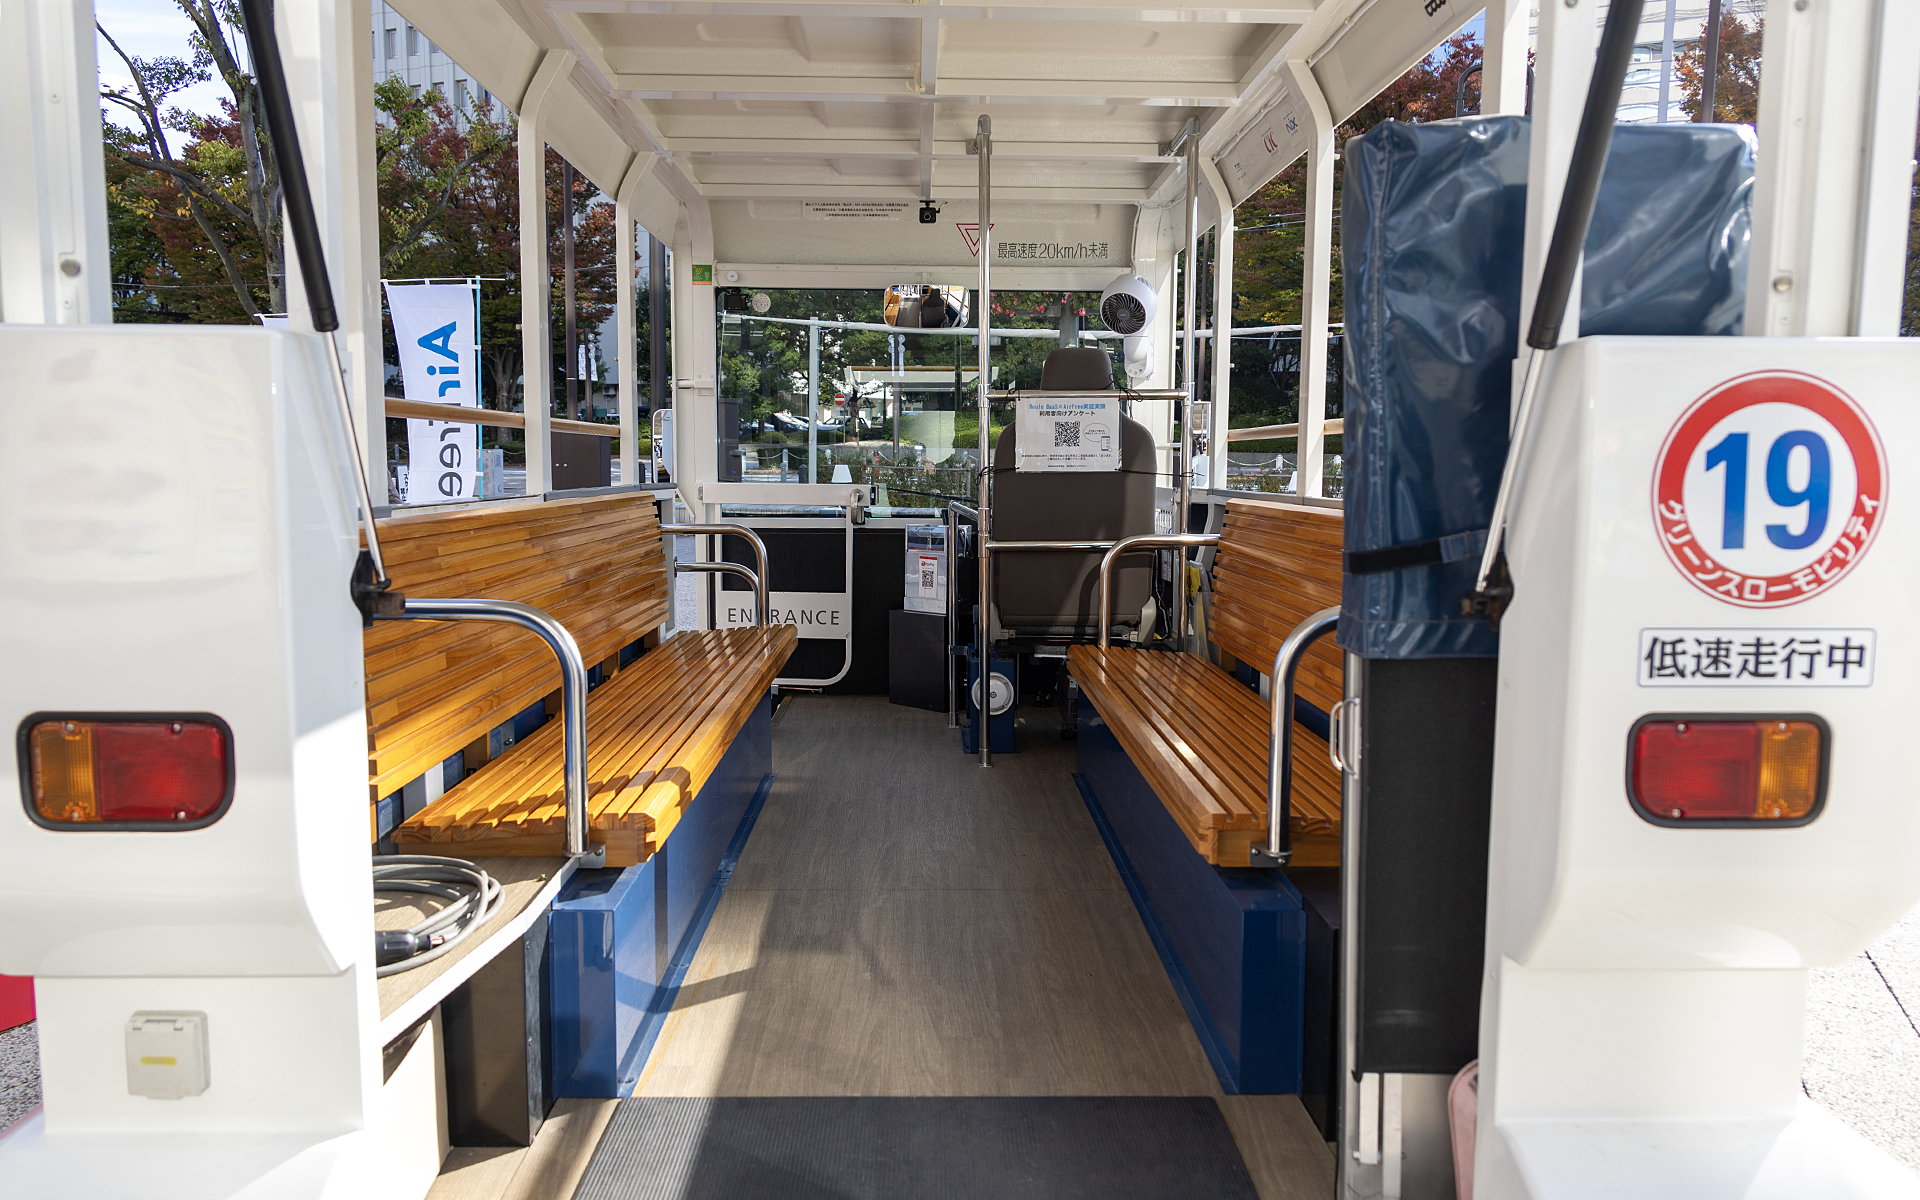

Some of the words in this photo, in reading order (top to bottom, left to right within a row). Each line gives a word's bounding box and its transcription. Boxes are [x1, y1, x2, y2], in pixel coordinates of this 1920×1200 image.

[997, 241, 1109, 259] 最高速度20km/h未満
[1703, 429, 1832, 550] 19
[1659, 493, 1881, 601] グリーンスローモビリティ
[727, 607, 840, 626] ENRANCE
[1644, 635, 1867, 680] 低速走行中
